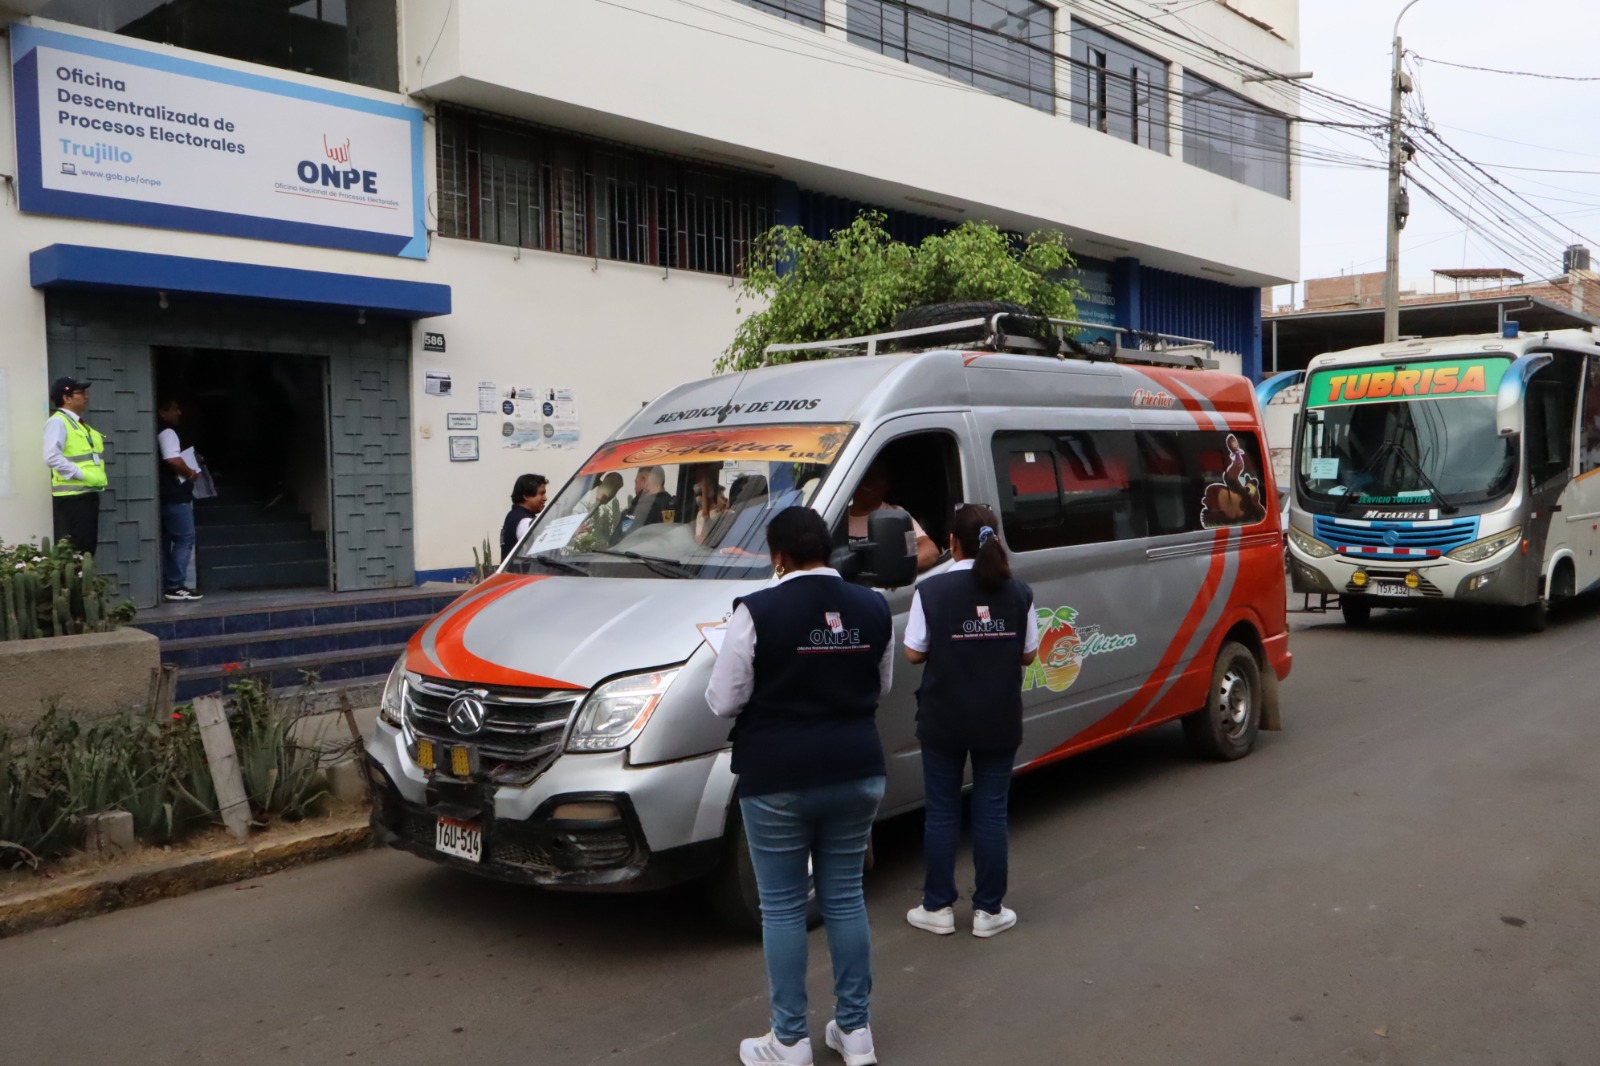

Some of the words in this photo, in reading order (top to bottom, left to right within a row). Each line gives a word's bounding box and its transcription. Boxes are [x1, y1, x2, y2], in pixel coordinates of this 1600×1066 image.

[56, 66, 126, 92] Oficina
[57, 88, 209, 128] Descentralizada
[214, 118, 235, 132] de
[58, 110, 145, 137] Procesos
[150, 126, 246, 155] Electorales
[59, 138, 132, 164] Trujillo
[81, 168, 162, 187] www.gob.pe/onpe
[297, 160, 378, 194] ONPE
[274, 182, 298, 191] Oficina
[299, 186, 328, 196] Nacional
[338, 192, 366, 202] Procesos
[367, 196, 399, 207] Electorales
[424, 335, 443, 346] 586
[1328, 365, 1487, 402] TUBRISA
[744, 401, 774, 414] DE
[771, 398, 821, 411] DIOS
[1358, 496, 1391, 504] SERVICIO
[810, 628, 860, 645] ONPE
[963, 619, 1005, 633] ONPE
[438, 823, 480, 856] T6U-514
